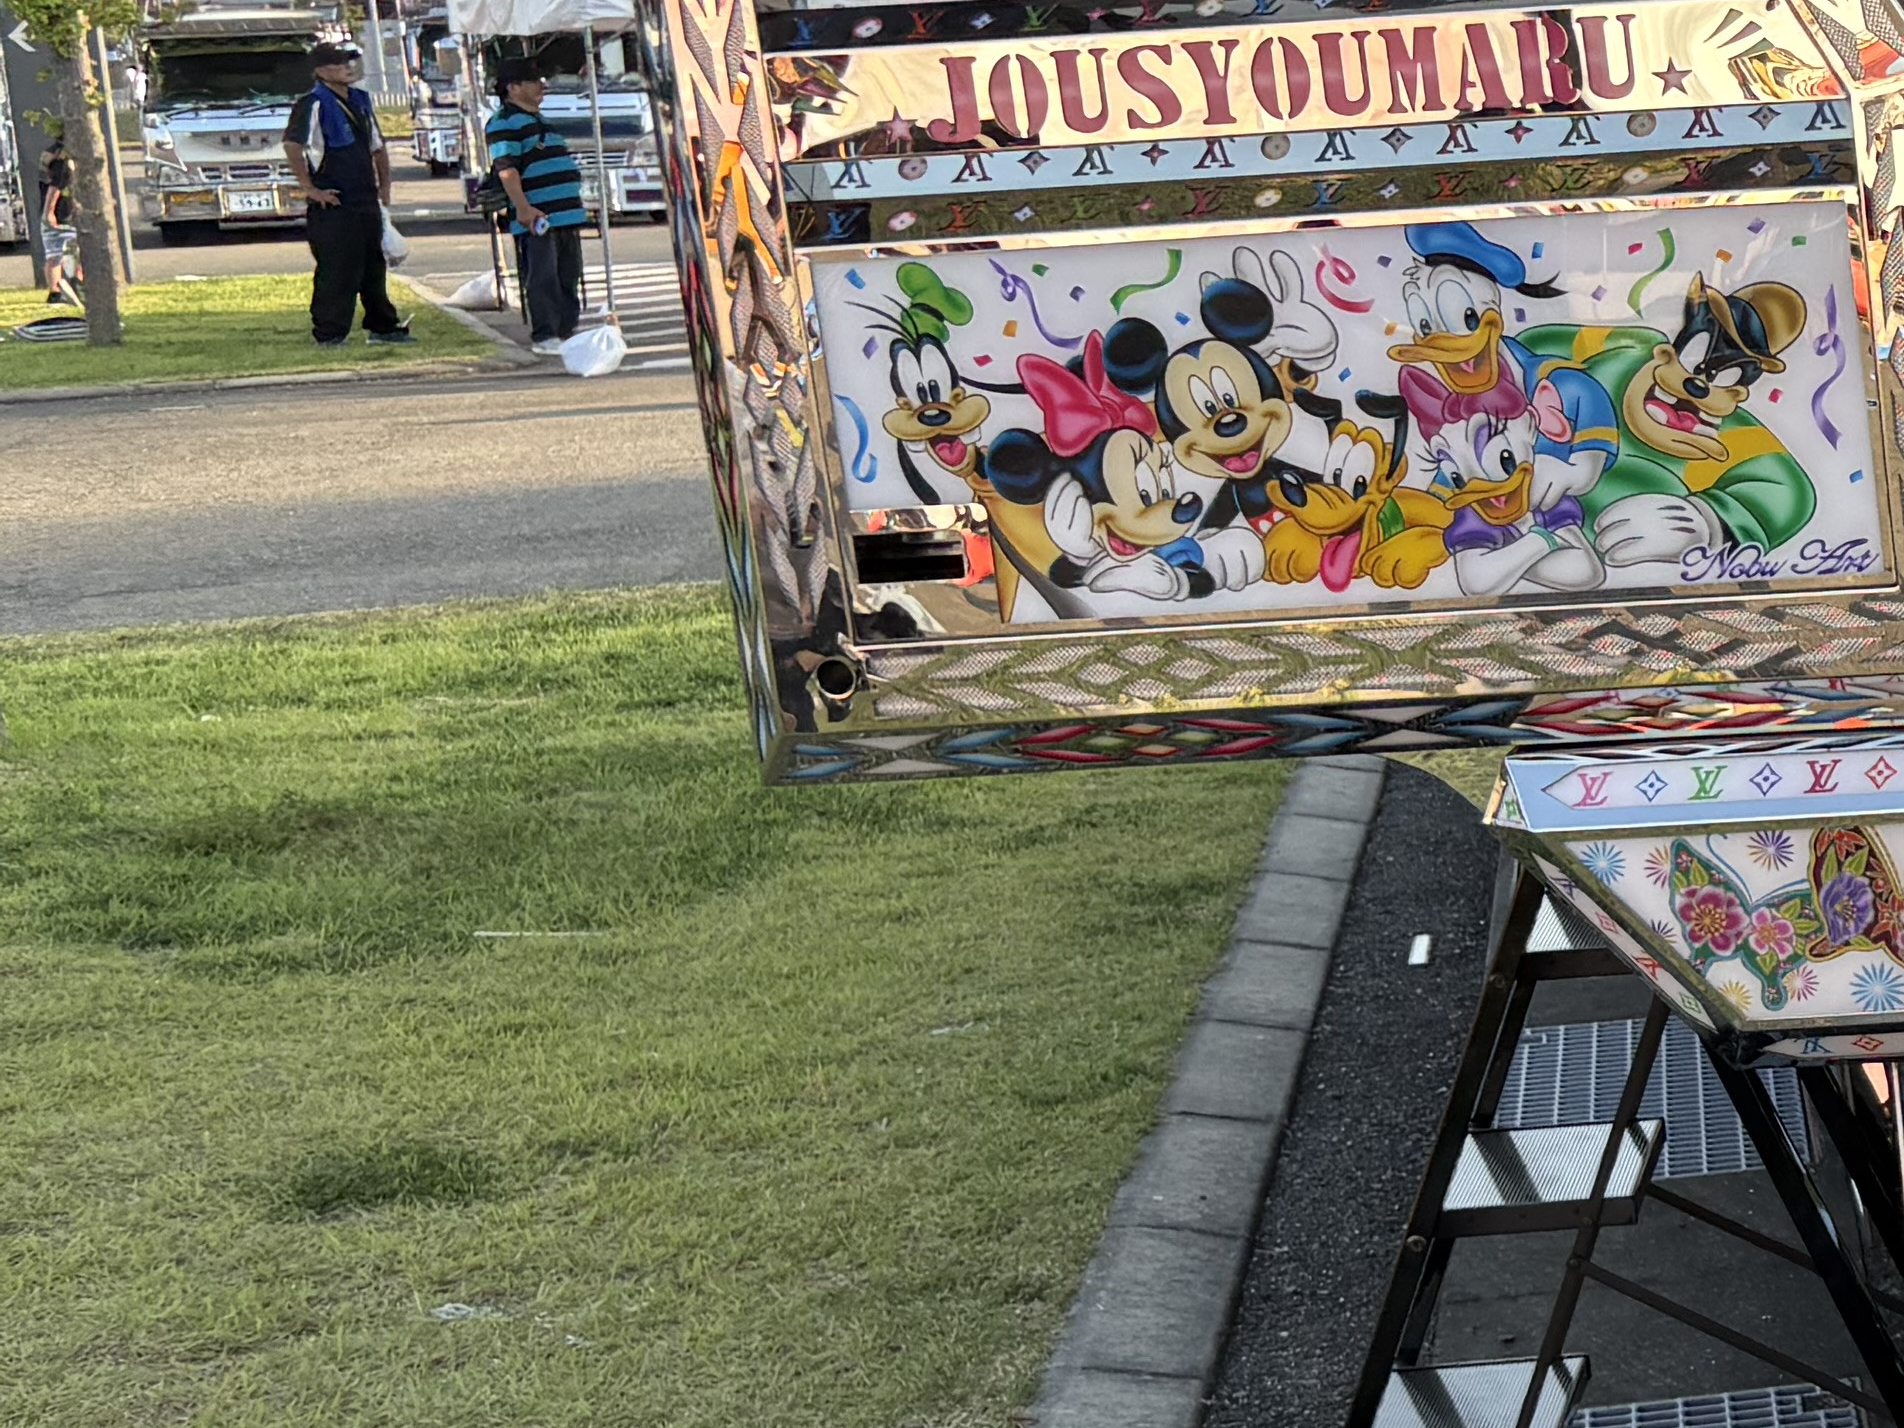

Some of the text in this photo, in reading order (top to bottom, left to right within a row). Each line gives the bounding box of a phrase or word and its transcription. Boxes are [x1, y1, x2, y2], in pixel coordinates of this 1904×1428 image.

[926, 14, 1635, 144] JOUSYOUMARU
[1680, 538, 1880, 582] Nobu Art
